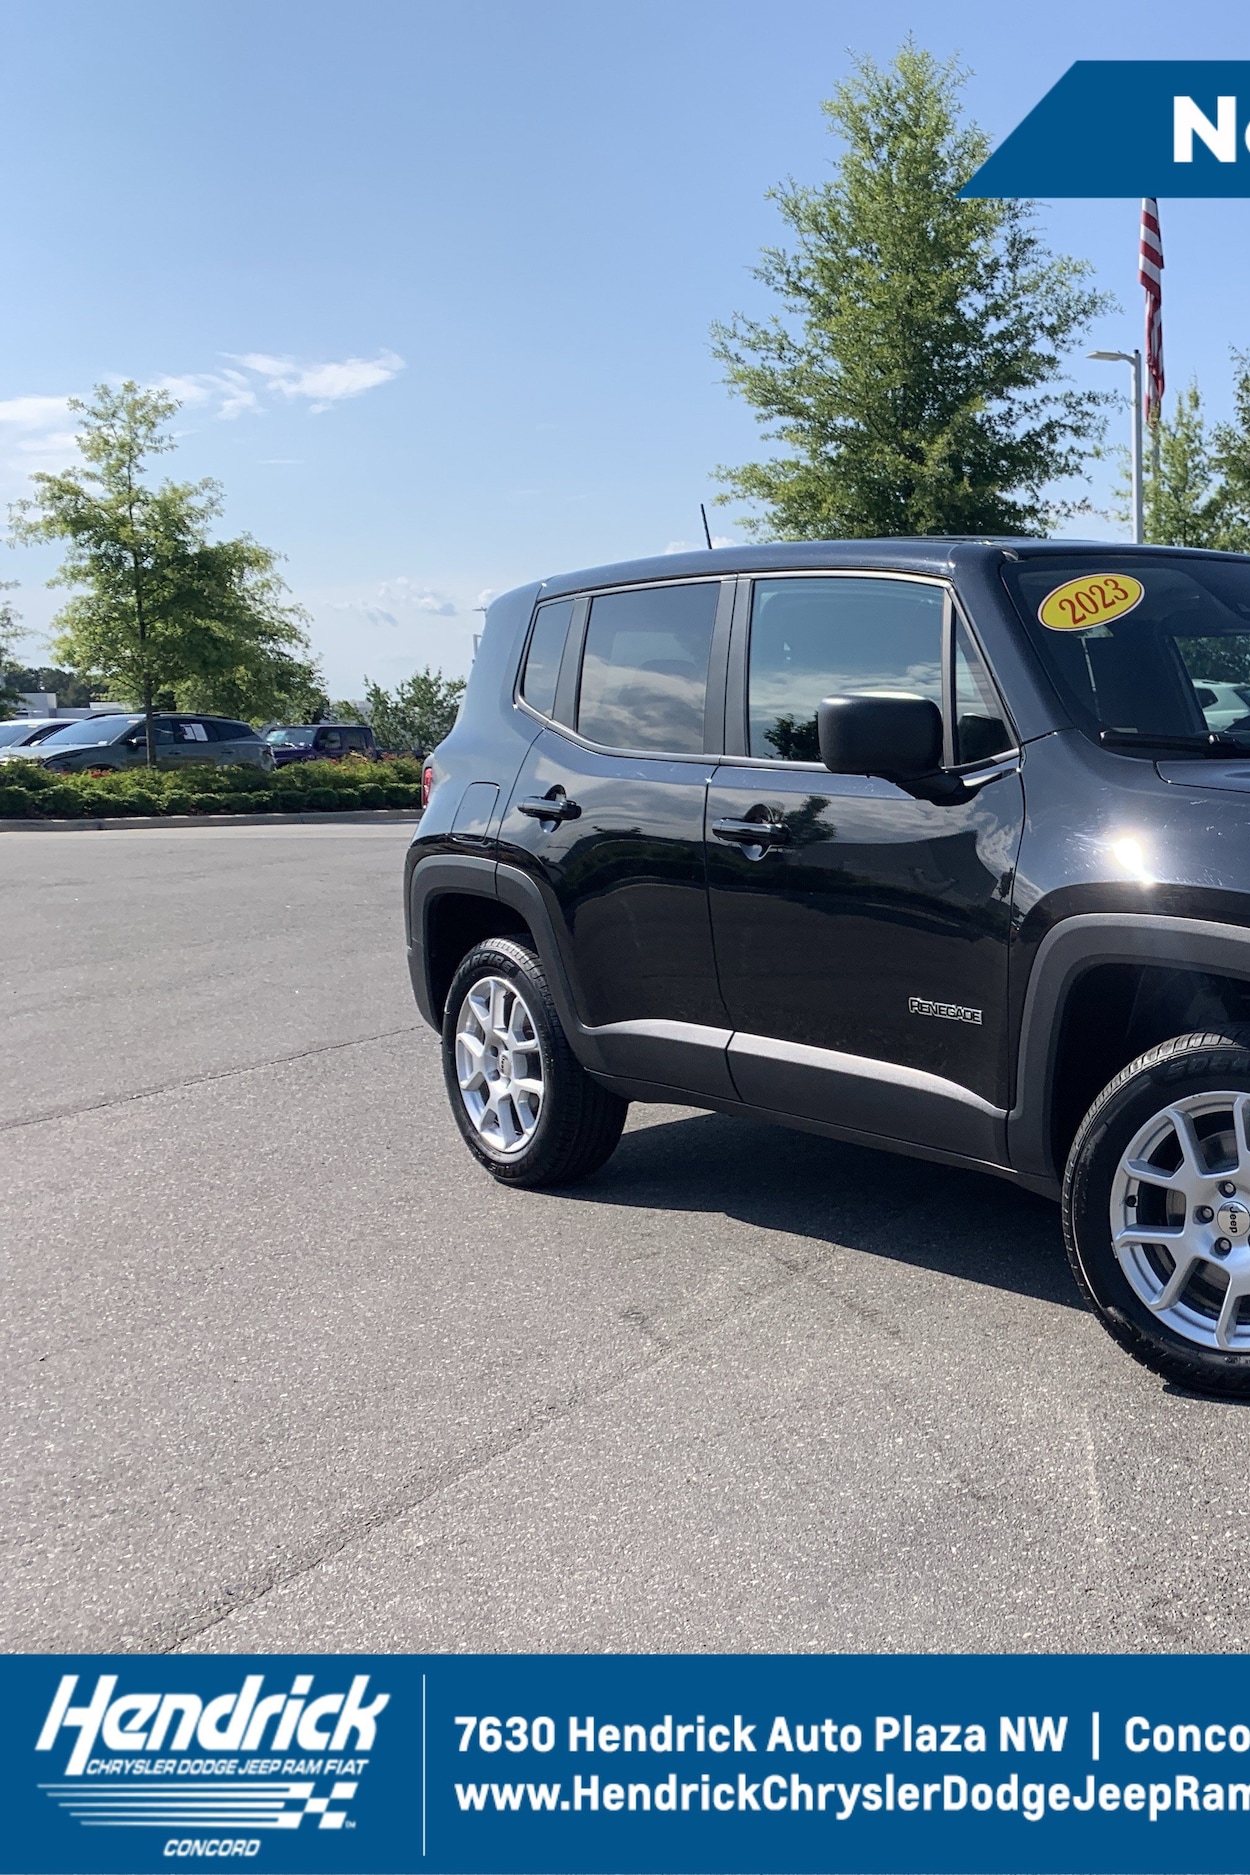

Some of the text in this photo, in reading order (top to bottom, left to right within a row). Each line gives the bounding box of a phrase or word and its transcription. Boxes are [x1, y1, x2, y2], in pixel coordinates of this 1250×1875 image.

[1059, 577, 1129, 624] 2023
[908, 996, 983, 1026] RENEGADE
[1228, 1206, 1239, 1234] Jeep
